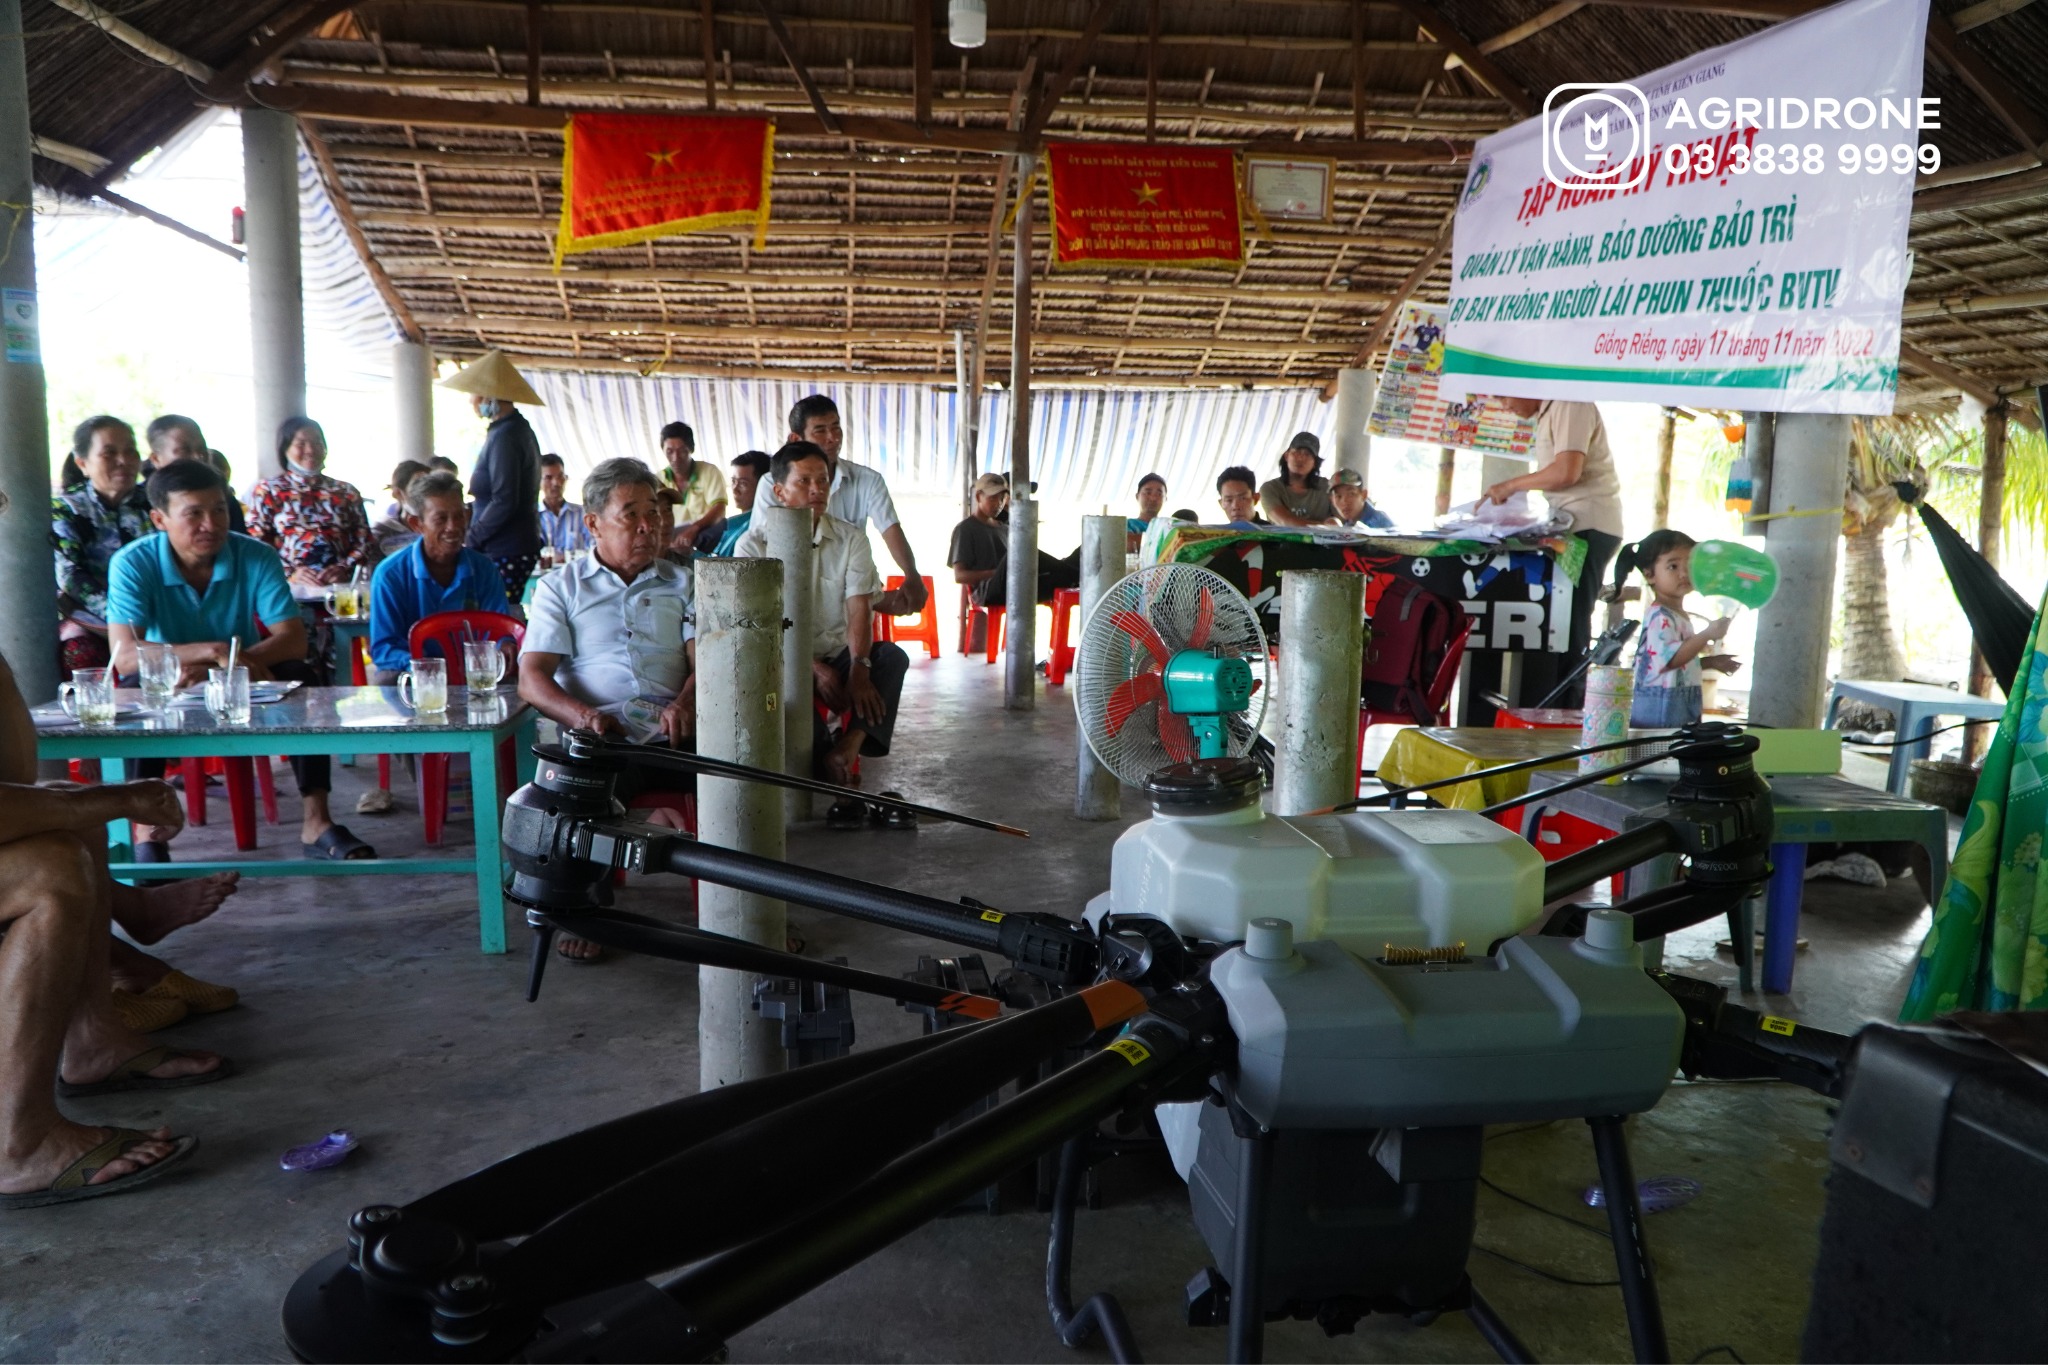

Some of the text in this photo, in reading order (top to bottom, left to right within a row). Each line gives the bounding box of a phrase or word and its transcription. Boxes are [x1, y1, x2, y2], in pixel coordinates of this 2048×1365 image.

[1696, 62, 1726, 84] GIANG
[1517, 177, 1557, 227] TẬP
[1556, 151, 1623, 212] HUẤN
[1623, 142, 1664, 197] KỸ
[1460, 193, 1797, 282] QUẢN LÝ VẬN HÀNH, BẢO DƯỠNG BẢO TRÌ
[1450, 260, 1842, 329] BỊ BAY KHÔNG NGƯỜI LÁI PHUN THUỐC BVTV
[1671, 331, 1707, 362] ngày
[1709, 328, 1729, 356] 17
[1727, 330, 1771, 363] tháng
[1773, 327, 1794, 356] 11
[1792, 329, 1829, 357] năm
